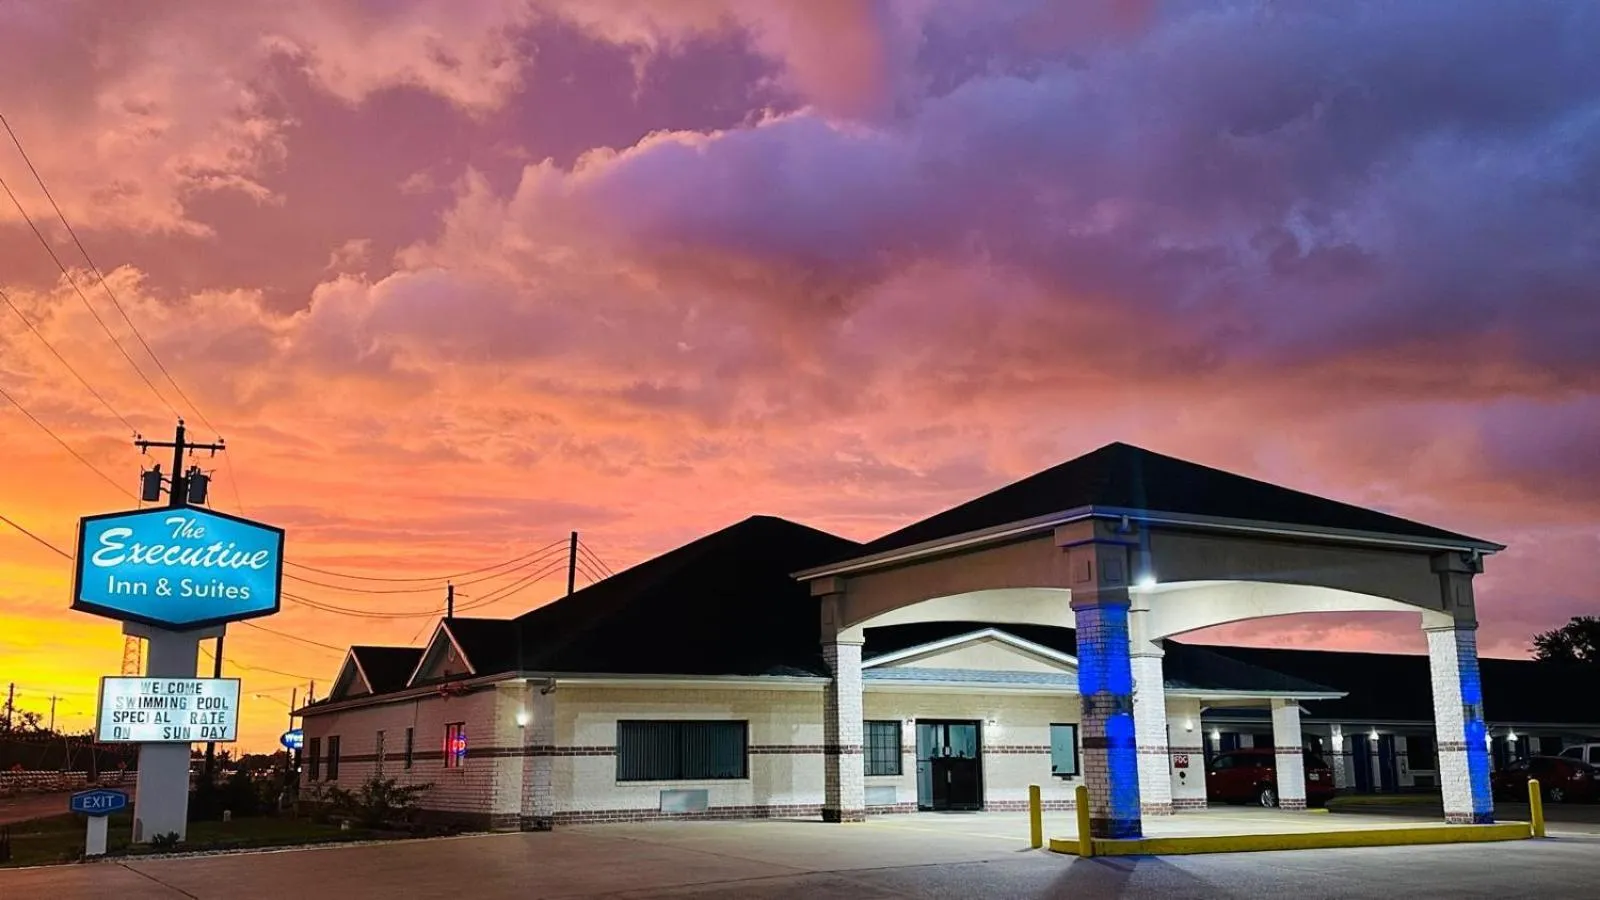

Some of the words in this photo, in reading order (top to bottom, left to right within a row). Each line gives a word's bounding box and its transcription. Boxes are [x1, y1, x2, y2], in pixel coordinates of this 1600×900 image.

[166, 517, 205, 539] The
[92, 528, 269, 569] Executive
[108, 576, 147, 595] Inn
[155, 578, 172, 597] &
[180, 579, 250, 599] Suites
[116, 697, 187, 709] SWIMMING
[197, 697, 228, 709] POOL
[190, 712, 225, 724] RATE
[113, 726, 131, 739] ON
[83, 796, 115, 808] EXIT
